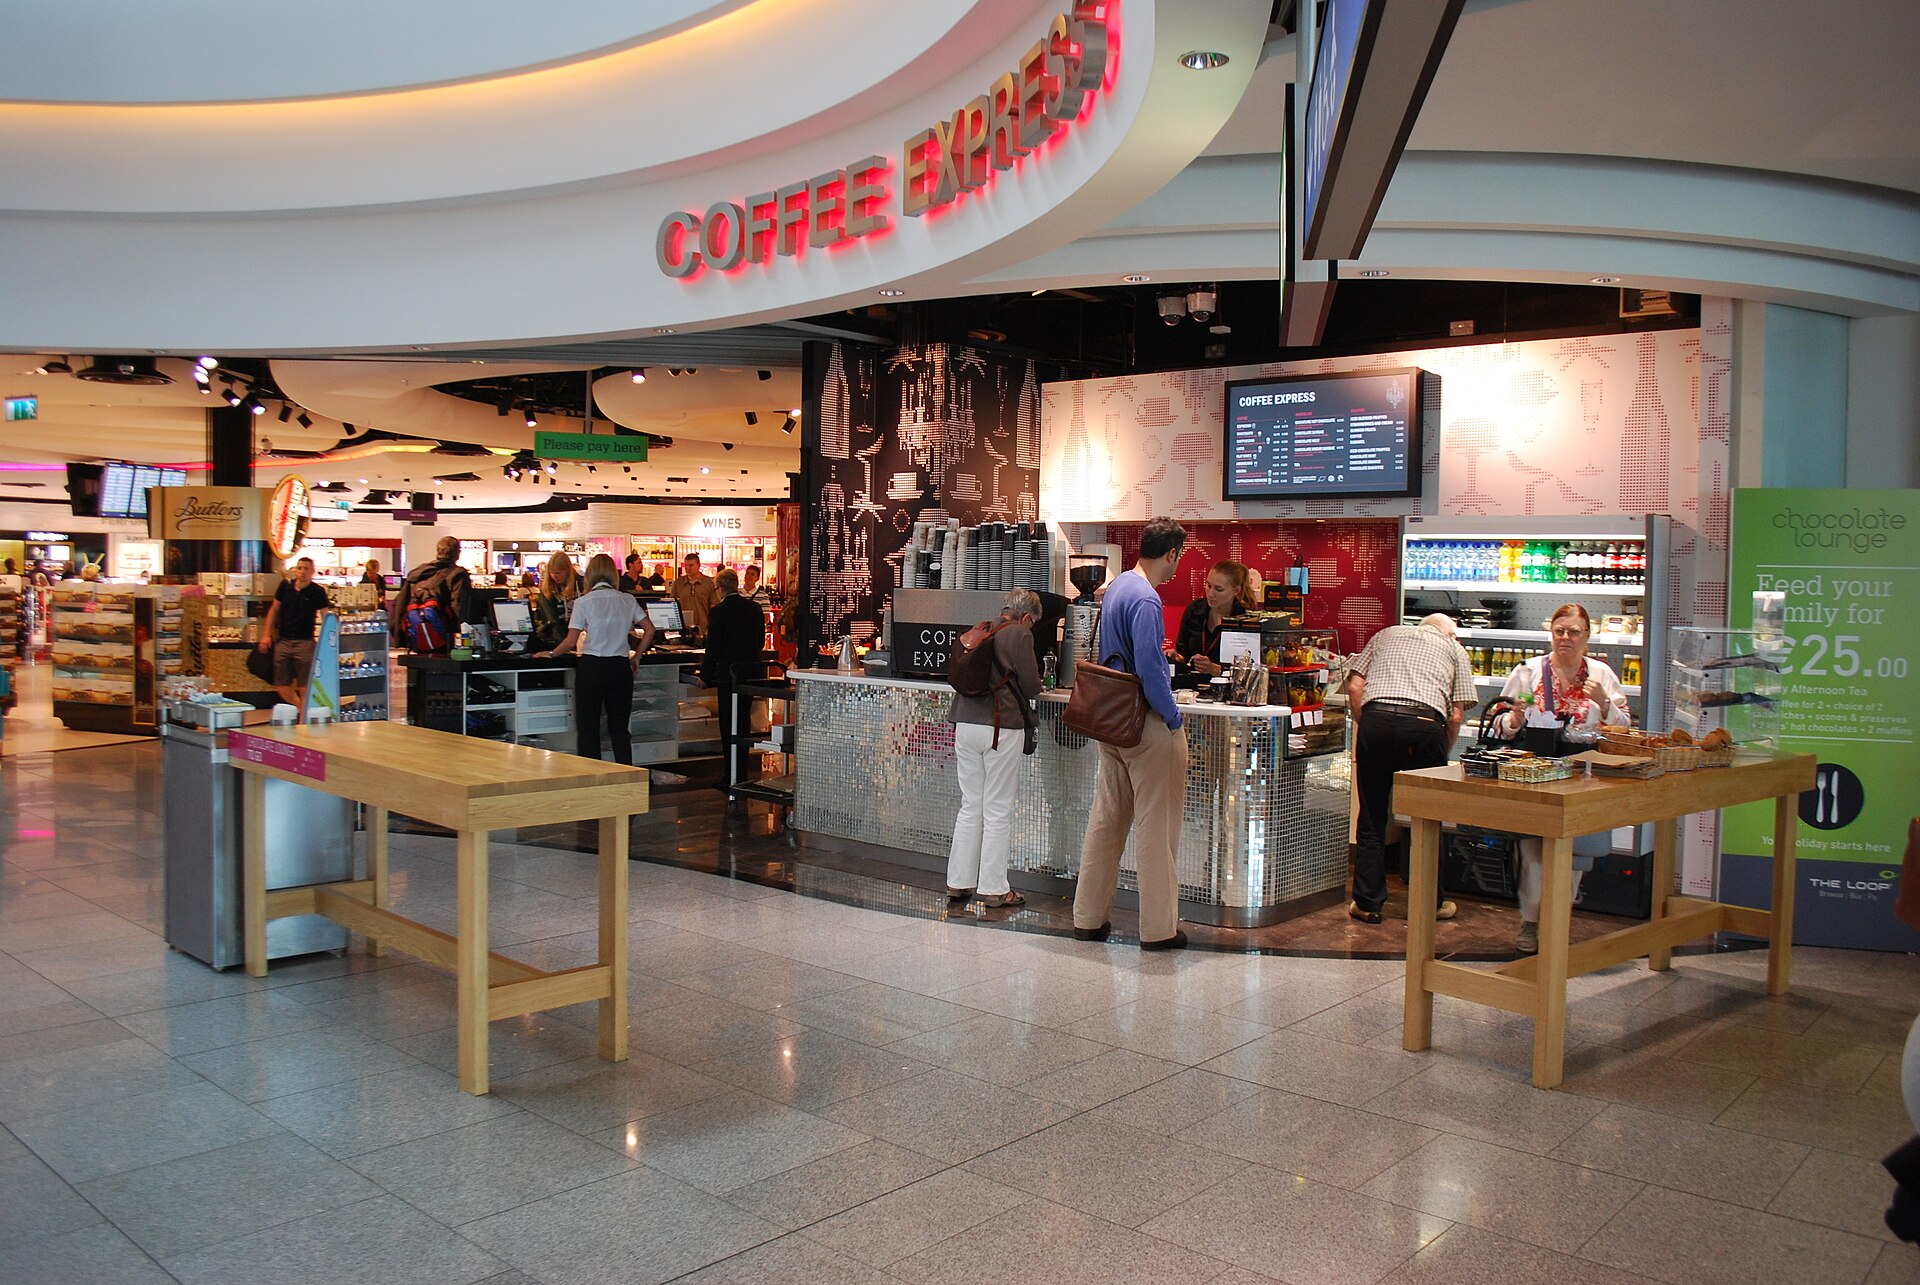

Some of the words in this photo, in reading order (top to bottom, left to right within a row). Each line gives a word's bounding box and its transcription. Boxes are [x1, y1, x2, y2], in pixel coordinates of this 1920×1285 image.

[656, 155, 887, 278] COFFEE
[903, 0, 1107, 217] EXPRESS
[1239, 394, 1273, 407] COFFEE
[1274, 392, 1316, 404] EXPRESS
[544, 438, 583, 450] Please
[587, 442, 610, 454] pay
[614, 442, 640, 453] here
[174, 496, 244, 526] Butlers
[702, 518, 742, 529] WINES
[1772, 508, 1906, 530] chocolate
[1794, 527, 1888, 554] lounge
[1756, 574, 1824, 596] Feed
[1831, 580, 1894, 600] your
[1778, 602, 1838, 628] mily
[1848, 603, 1886, 624] for
[1791, 684, 1845, 696] Afternoon
[1850, 686, 1868, 696] Tea
[1802, 701, 1815, 709] for
[1833, 701, 1863, 711] choice
[1865, 702, 1876, 711] of
[1815, 713, 1848, 722] scones
[1859, 715, 1907, 724] preserves
[1790, 722, 1806, 731] hot
[1808, 724, 1857, 733] chocolates
[1795, 839, 1828, 850] oliday
[1830, 841, 1863, 850] starts
[1865, 843, 1891, 853] here
[1809, 878, 1841, 889] THE
[1846, 880, 1890, 891] LOOP
